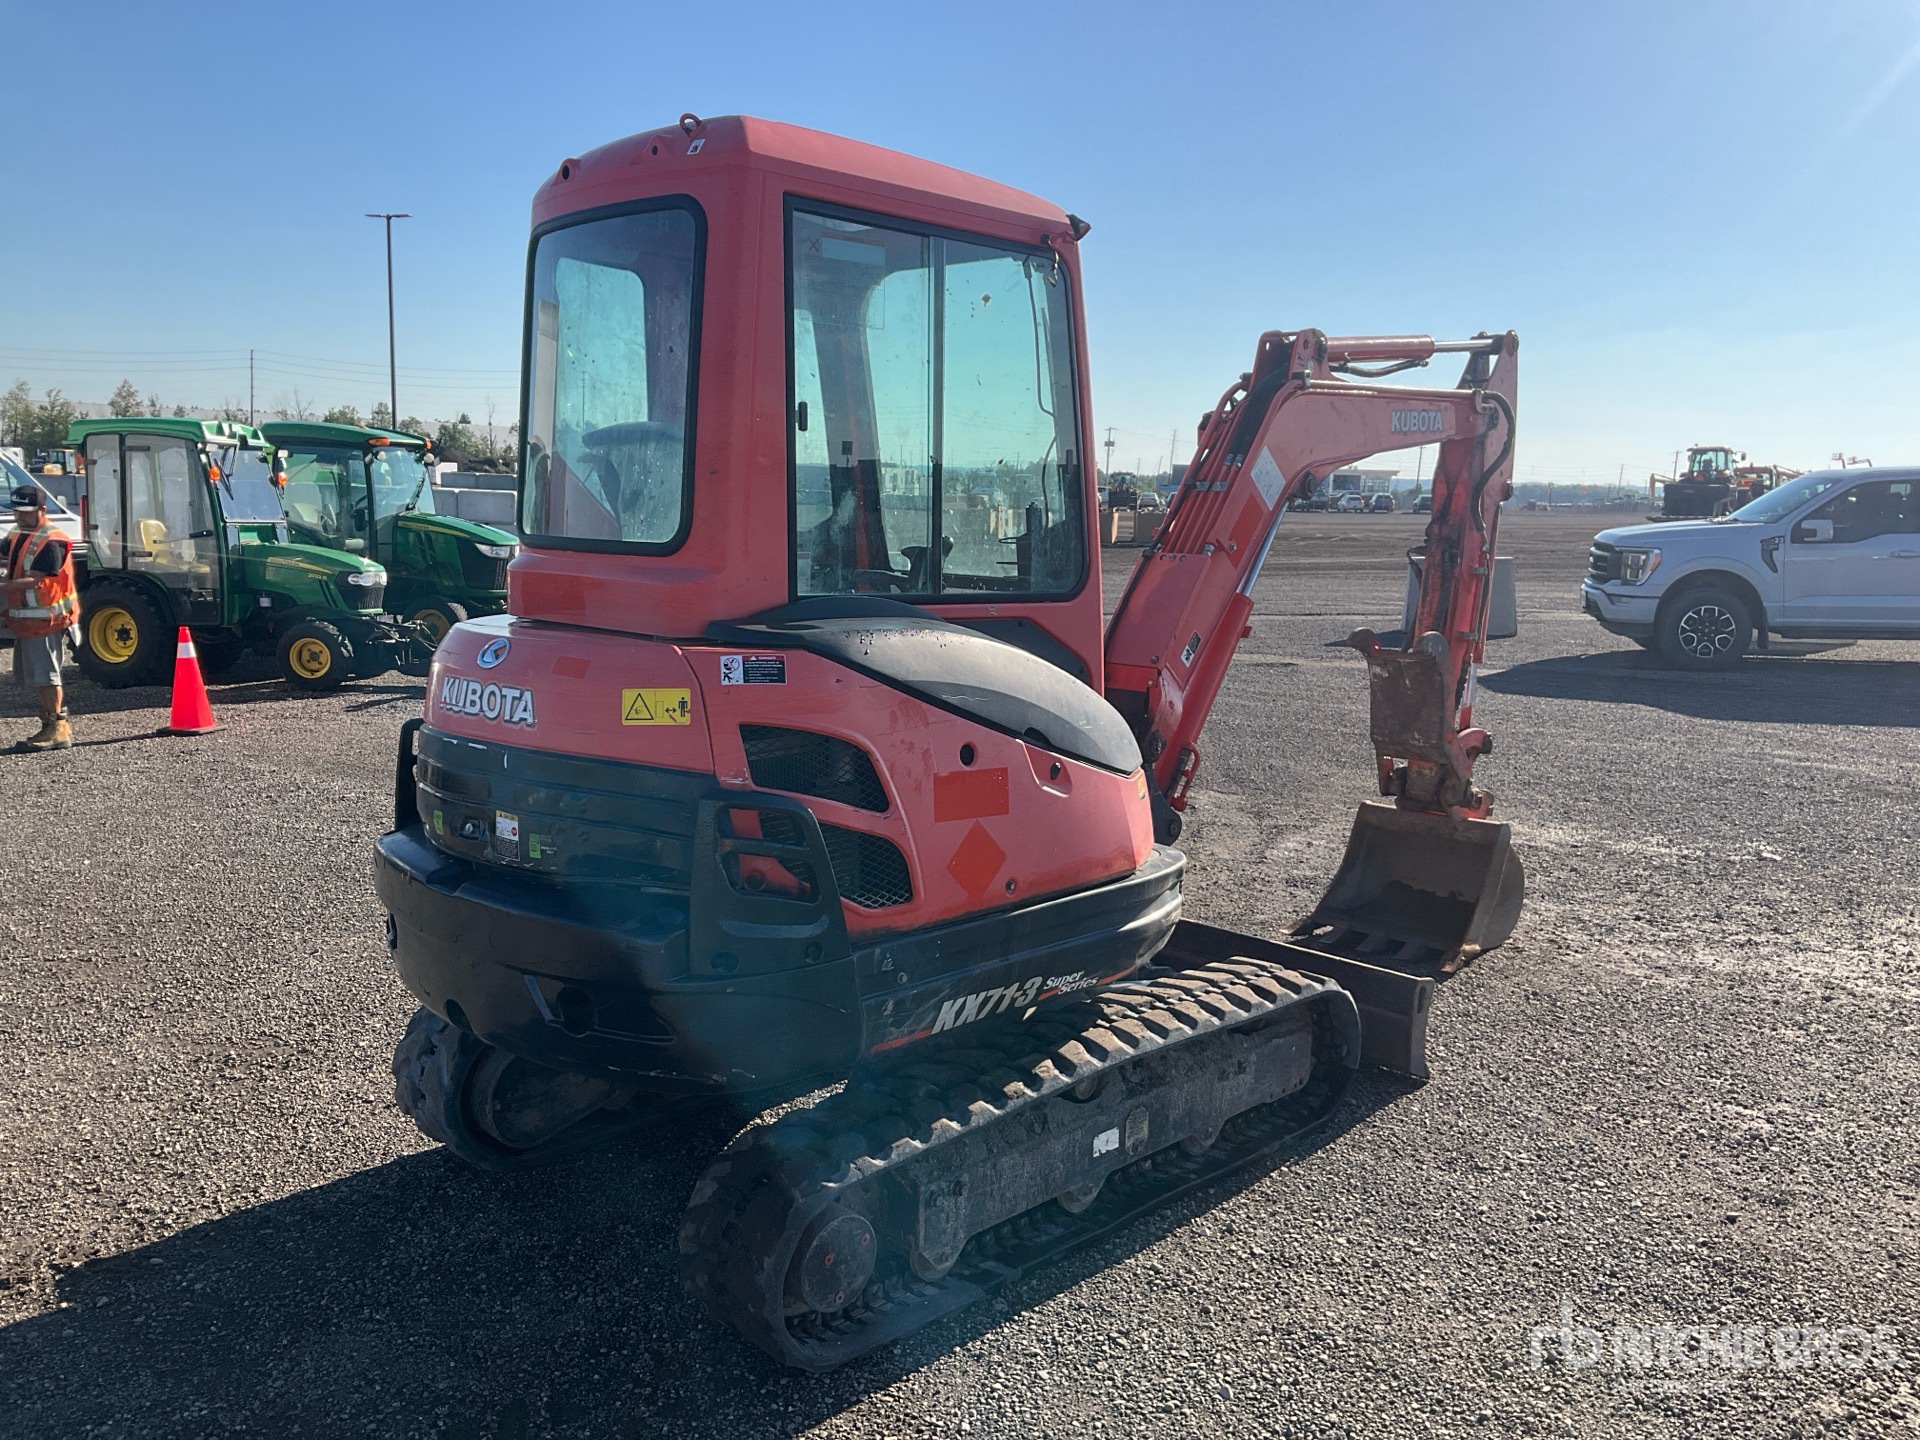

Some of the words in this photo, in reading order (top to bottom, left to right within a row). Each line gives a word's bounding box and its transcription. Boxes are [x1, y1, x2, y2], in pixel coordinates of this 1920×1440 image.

[1391, 410, 1443, 432] KUBOTA
[441, 675, 536, 726] KUBOTA
[1043, 970, 1085, 990] Super
[1058, 977, 1099, 995] Series
[931, 976, 1043, 1035] KX71-3
